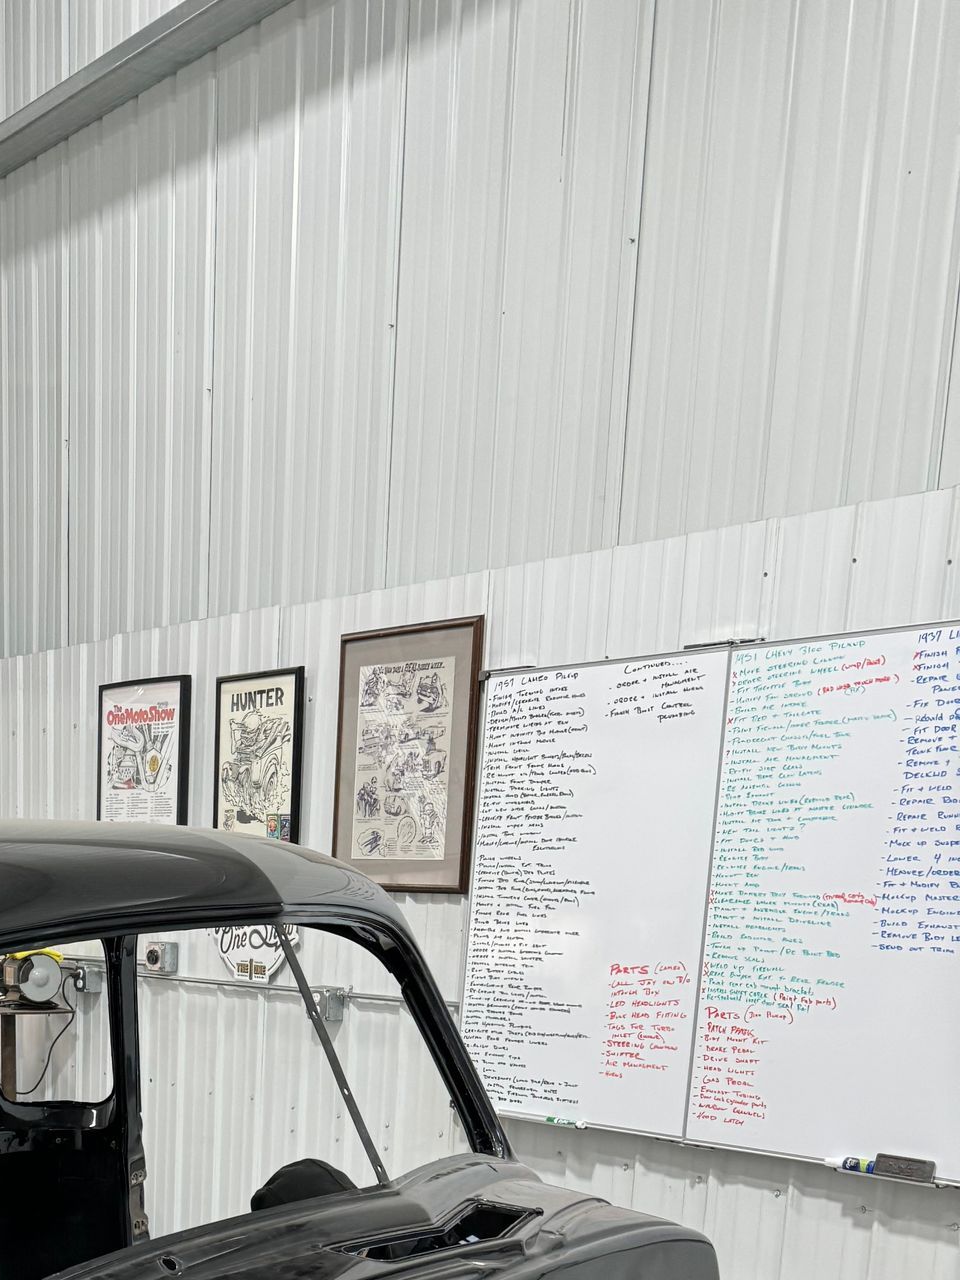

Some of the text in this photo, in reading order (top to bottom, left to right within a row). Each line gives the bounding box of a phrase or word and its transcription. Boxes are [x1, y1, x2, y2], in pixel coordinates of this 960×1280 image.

[919, 630, 942, 643] 1937
[916, 675, 947, 684] REPAIR
[231, 687, 284, 712] HUNTER
[913, 699, 929, 708] FIX
[113, 704, 123, 714] The
[913, 725, 956, 736] FIT DOOR
[907, 736, 943, 745] REMOVE
[901, 785, 913, 794] FIT
[899, 798, 936, 806] REPAIR
[896, 812, 928, 821] REPAIR
[886, 853, 942, 864] LOWER 4
[880, 919, 908, 928] BUILD
[881, 930, 945, 942] REMOVE BODY
[879, 943, 903, 951] SEND
[610, 964, 649, 975] PARTS
[632, 999, 680, 1007] HEADLIGHTS
[705, 1006, 741, 1020] PARTS
[607, 1040, 645, 1049] STEERING
[731, 1046, 756, 1054] PEDAL
[703, 1054, 728, 1062] DRIVE
[725, 1077, 754, 1087] PEDAL
[723, 1118, 745, 1126] LATCH
